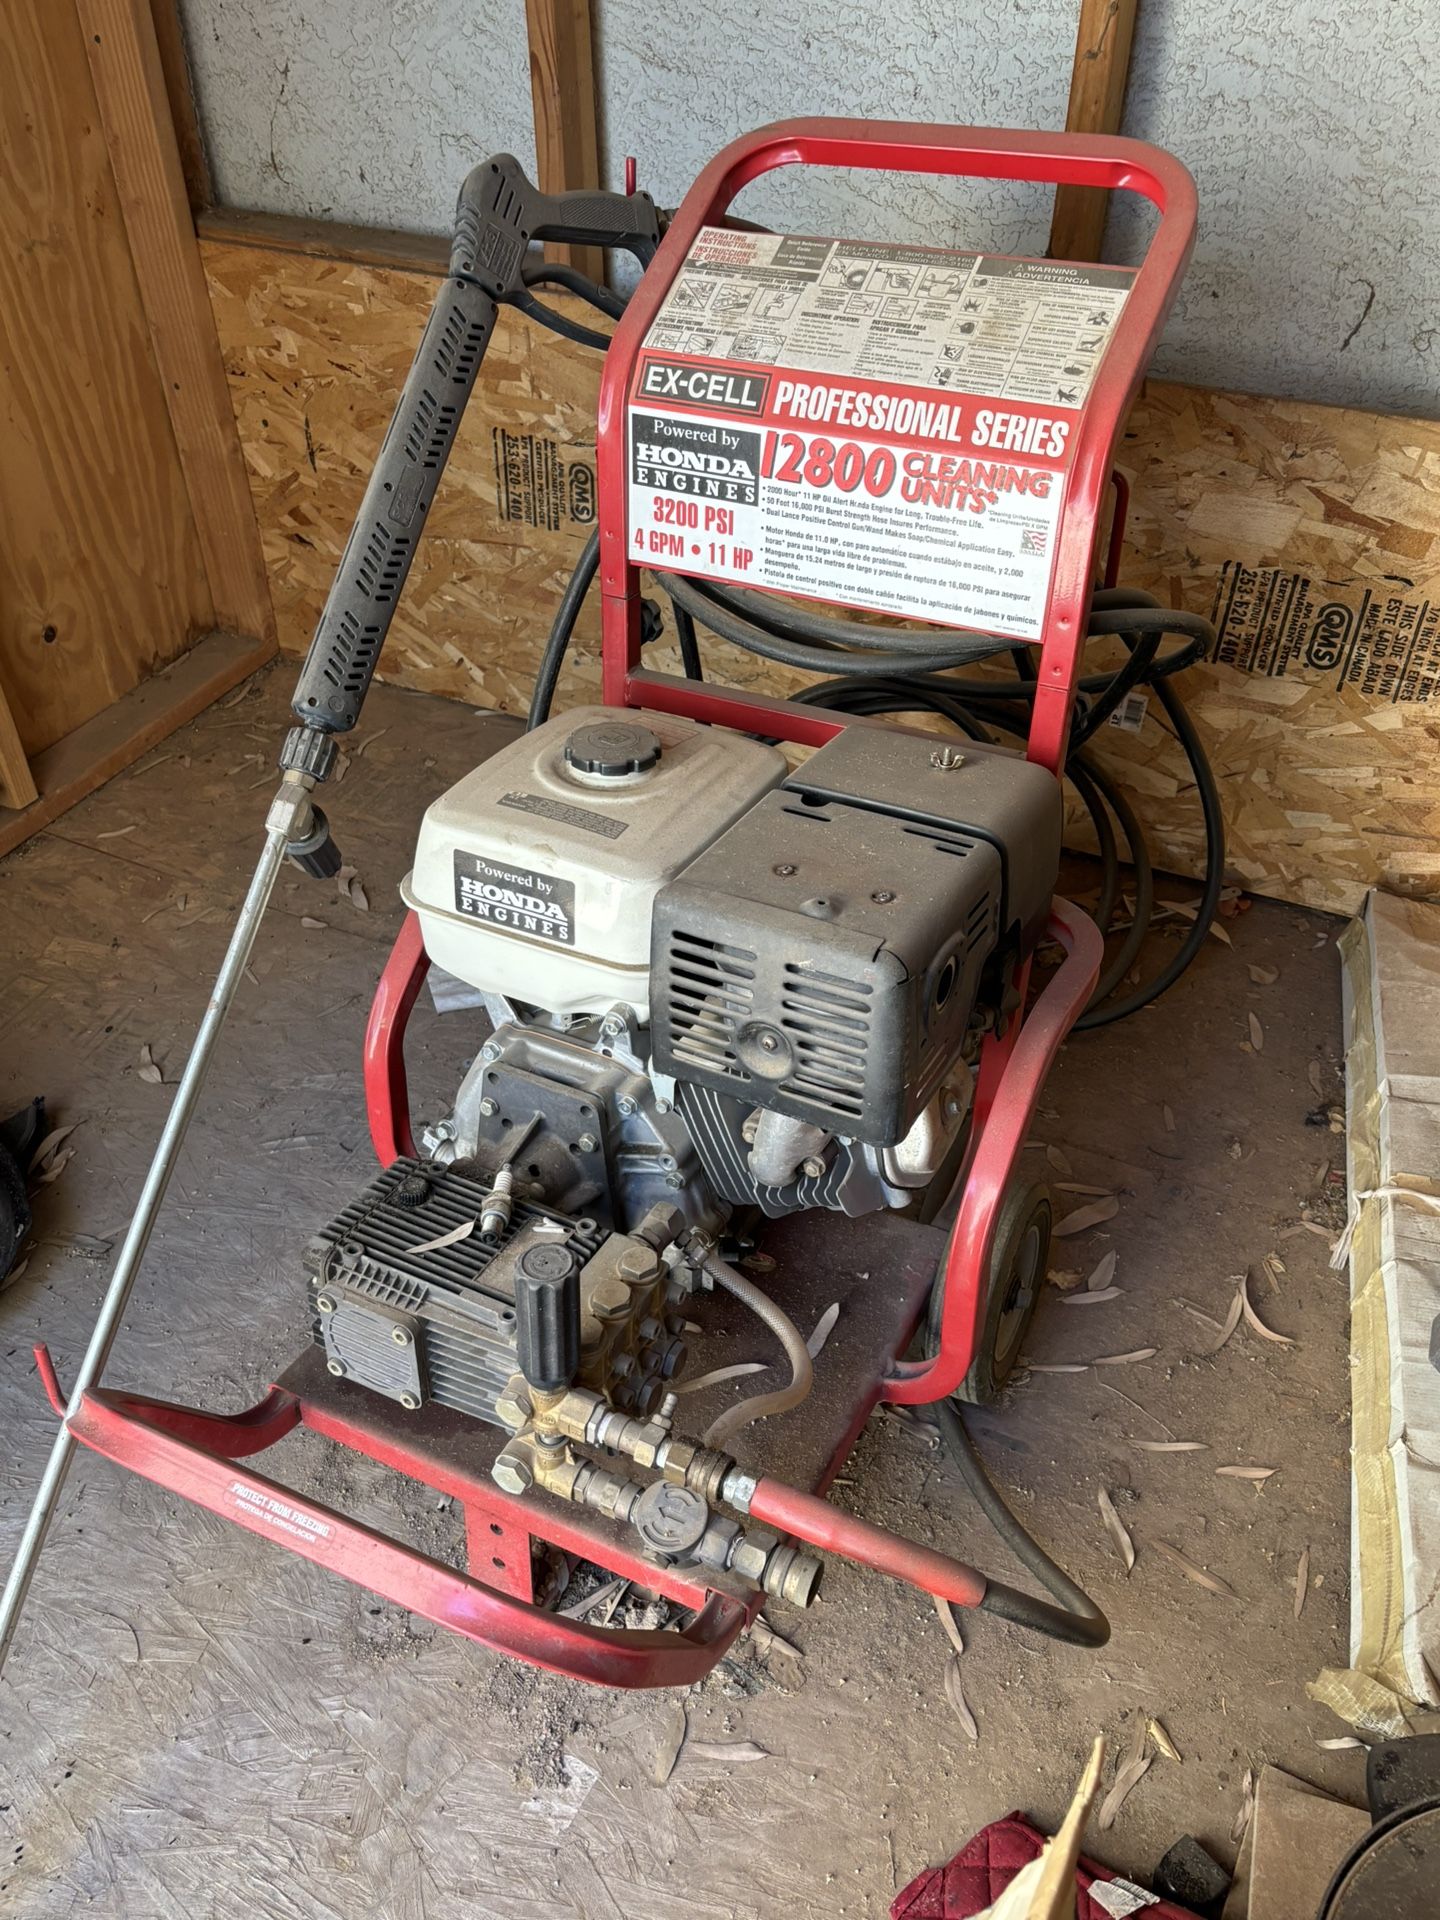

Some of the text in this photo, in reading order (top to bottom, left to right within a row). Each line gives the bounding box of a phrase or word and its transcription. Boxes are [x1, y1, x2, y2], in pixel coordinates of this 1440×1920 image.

[691, 252, 703, 261] DE
[694, 245, 758, 259] INSTRUCCIONES
[700, 236, 758, 250] INSTRUCTIONS
[702, 230, 747, 242] OPERATING
[1014, 271, 1090, 286] ADVERTENCIA
[1027, 265, 1078, 276] WARNING
[645, 365, 756, 406] EX-CELL
[654, 419, 739, 449] Powered by
[772, 380, 961, 442] PROFESSIONAL
[970, 409, 1069, 457] SERIES
[505, 433, 523, 521] 253-620-7400
[636, 442, 755, 479] HONDA
[759, 429, 897, 498] 12800
[902, 451, 1053, 498] CLEANING
[572, 466, 590, 517] QMS
[637, 467, 754, 502] ENGINES
[653, 495, 733, 535] 3200 PSI
[766, 496, 958, 536] 50 Foot 16,000 PSI Burst Strength Hose Insures Performance.
[767, 485, 782, 494] 2000
[803, 491, 810, 499] 11
[812, 492, 821, 500] HP
[822, 494, 831, 502] Oil
[832, 496, 848, 506] Alert
[870, 502, 892, 513] Engine
[894, 506, 903, 514] for
[905, 508, 923, 519] Long,
[968, 519, 983, 528] Life.
[634, 527, 753, 570] 4 GPM 11 HP
[765, 525, 783, 534] Motor
[784, 528, 804, 538] Honda
[805, 532, 813, 540] de
[814, 534, 828, 543] 11.0
[829, 536, 840, 546] HP,
[908, 552, 932, 561] cuando
[972, 563, 996, 573] aceite,
[998, 567, 1002, 575] y
[1003, 567, 1023, 577] 2,000
[766, 507, 780, 516] Dual
[781, 510, 799, 520] Lance
[800, 513, 826, 524] Positive
[827, 518, 850, 528] Control
[851, 522, 883, 534] Gun/Wand
[884, 528, 906, 538] Makes
[907, 532, 955, 547] Soap/Chemical
[957, 541, 995, 553] Application
[996, 547, 1014, 558] Easy.
[764, 546, 794, 558] Manguera
[795, 552, 803, 560] de
[805, 554, 822, 563] 15.24
[823, 559, 845, 568] metros
[846, 562, 854, 570] de
[903, 572, 912, 580] de
[913, 575, 936, 584] ruptura
[948, 580, 970, 591] 16,000
[972, 584, 983, 592] PSI
[984, 588, 999, 596] para
[1001, 591, 1030, 601] asegurar
[786, 541, 800, 549] para
[814, 545, 830, 555] larga
[832, 549, 845, 557] vida
[846, 551, 861, 560] libre
[862, 554, 870, 562] de
[871, 556, 906, 568] problemas.
[764, 567, 785, 578] Pistola
[786, 572, 793, 580] de
[795, 575, 816, 584] control
[817, 579, 842, 589] positivo
[856, 585, 873, 595] doble
[896, 592, 919, 603] facilita
[920, 597, 927, 605] la
[963, 605, 972, 613] de
[973, 607, 999, 618] jabones
[1269, 576, 1291, 622] CERTIFIED
[1300, 601, 1314, 620] APA
[1219, 567, 1258, 665] 253-620-7400
[1274, 577, 1311, 677] MANAGEMENT SYSTEM
[1313, 609, 1346, 663] QMS
[1348, 603, 1382, 683] MADE IN CANADA
[1361, 598, 1403, 695] ESTE LADO ABAJO
[1378, 604, 1419, 697] THIS SIDE DOWN
[1416, 627, 1434, 652] INCH
[1412, 655, 1425, 668] AT
[1400, 670, 1420, 701] EDGES
[1416, 676, 1434, 702] ENDS
[461, 876, 566, 922] HONDA
[476, 860, 553, 895] Powered by
[462, 895, 569, 940] ENGINES
[231, 1483, 330, 1537] PROTECT FROM FREEZING
